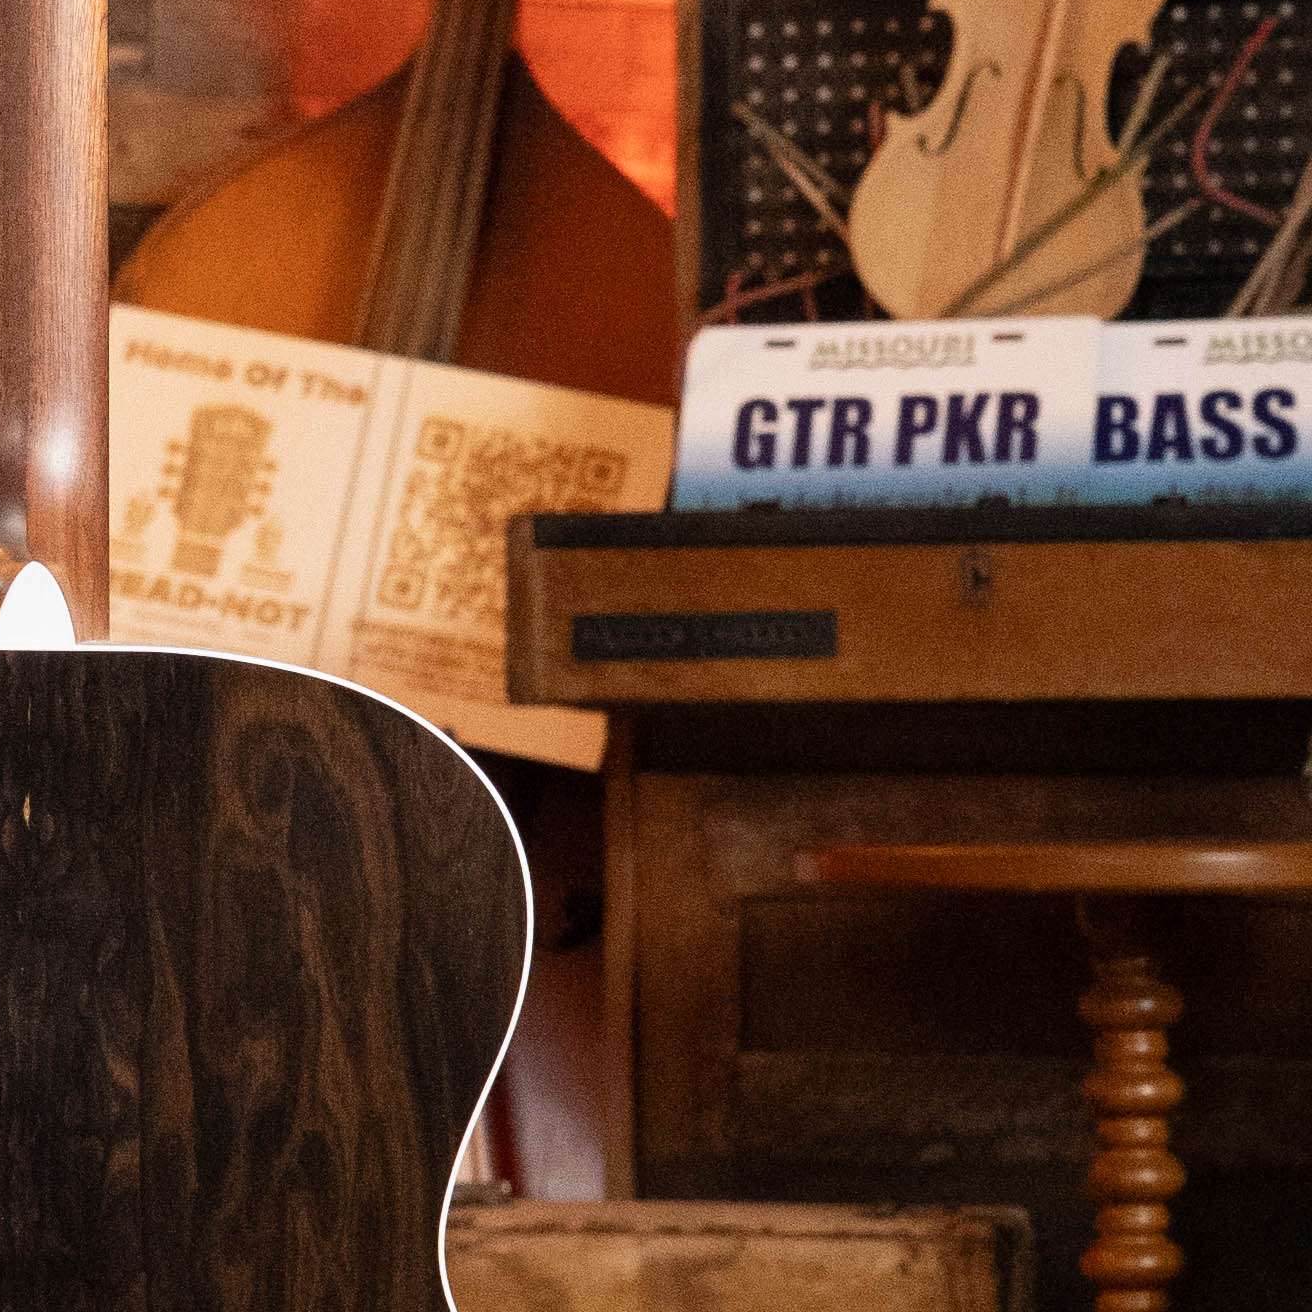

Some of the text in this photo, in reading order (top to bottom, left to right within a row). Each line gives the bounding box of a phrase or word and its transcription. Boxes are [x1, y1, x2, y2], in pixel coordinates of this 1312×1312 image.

[124, 341, 370, 406] Home Of The
[813, 333, 977, 366] MISSOURI
[731, 391, 1042, 471] GTR PKR
[1093, 385, 1300, 465] BASS
[111, 567, 310, 631] EAD-NOT
